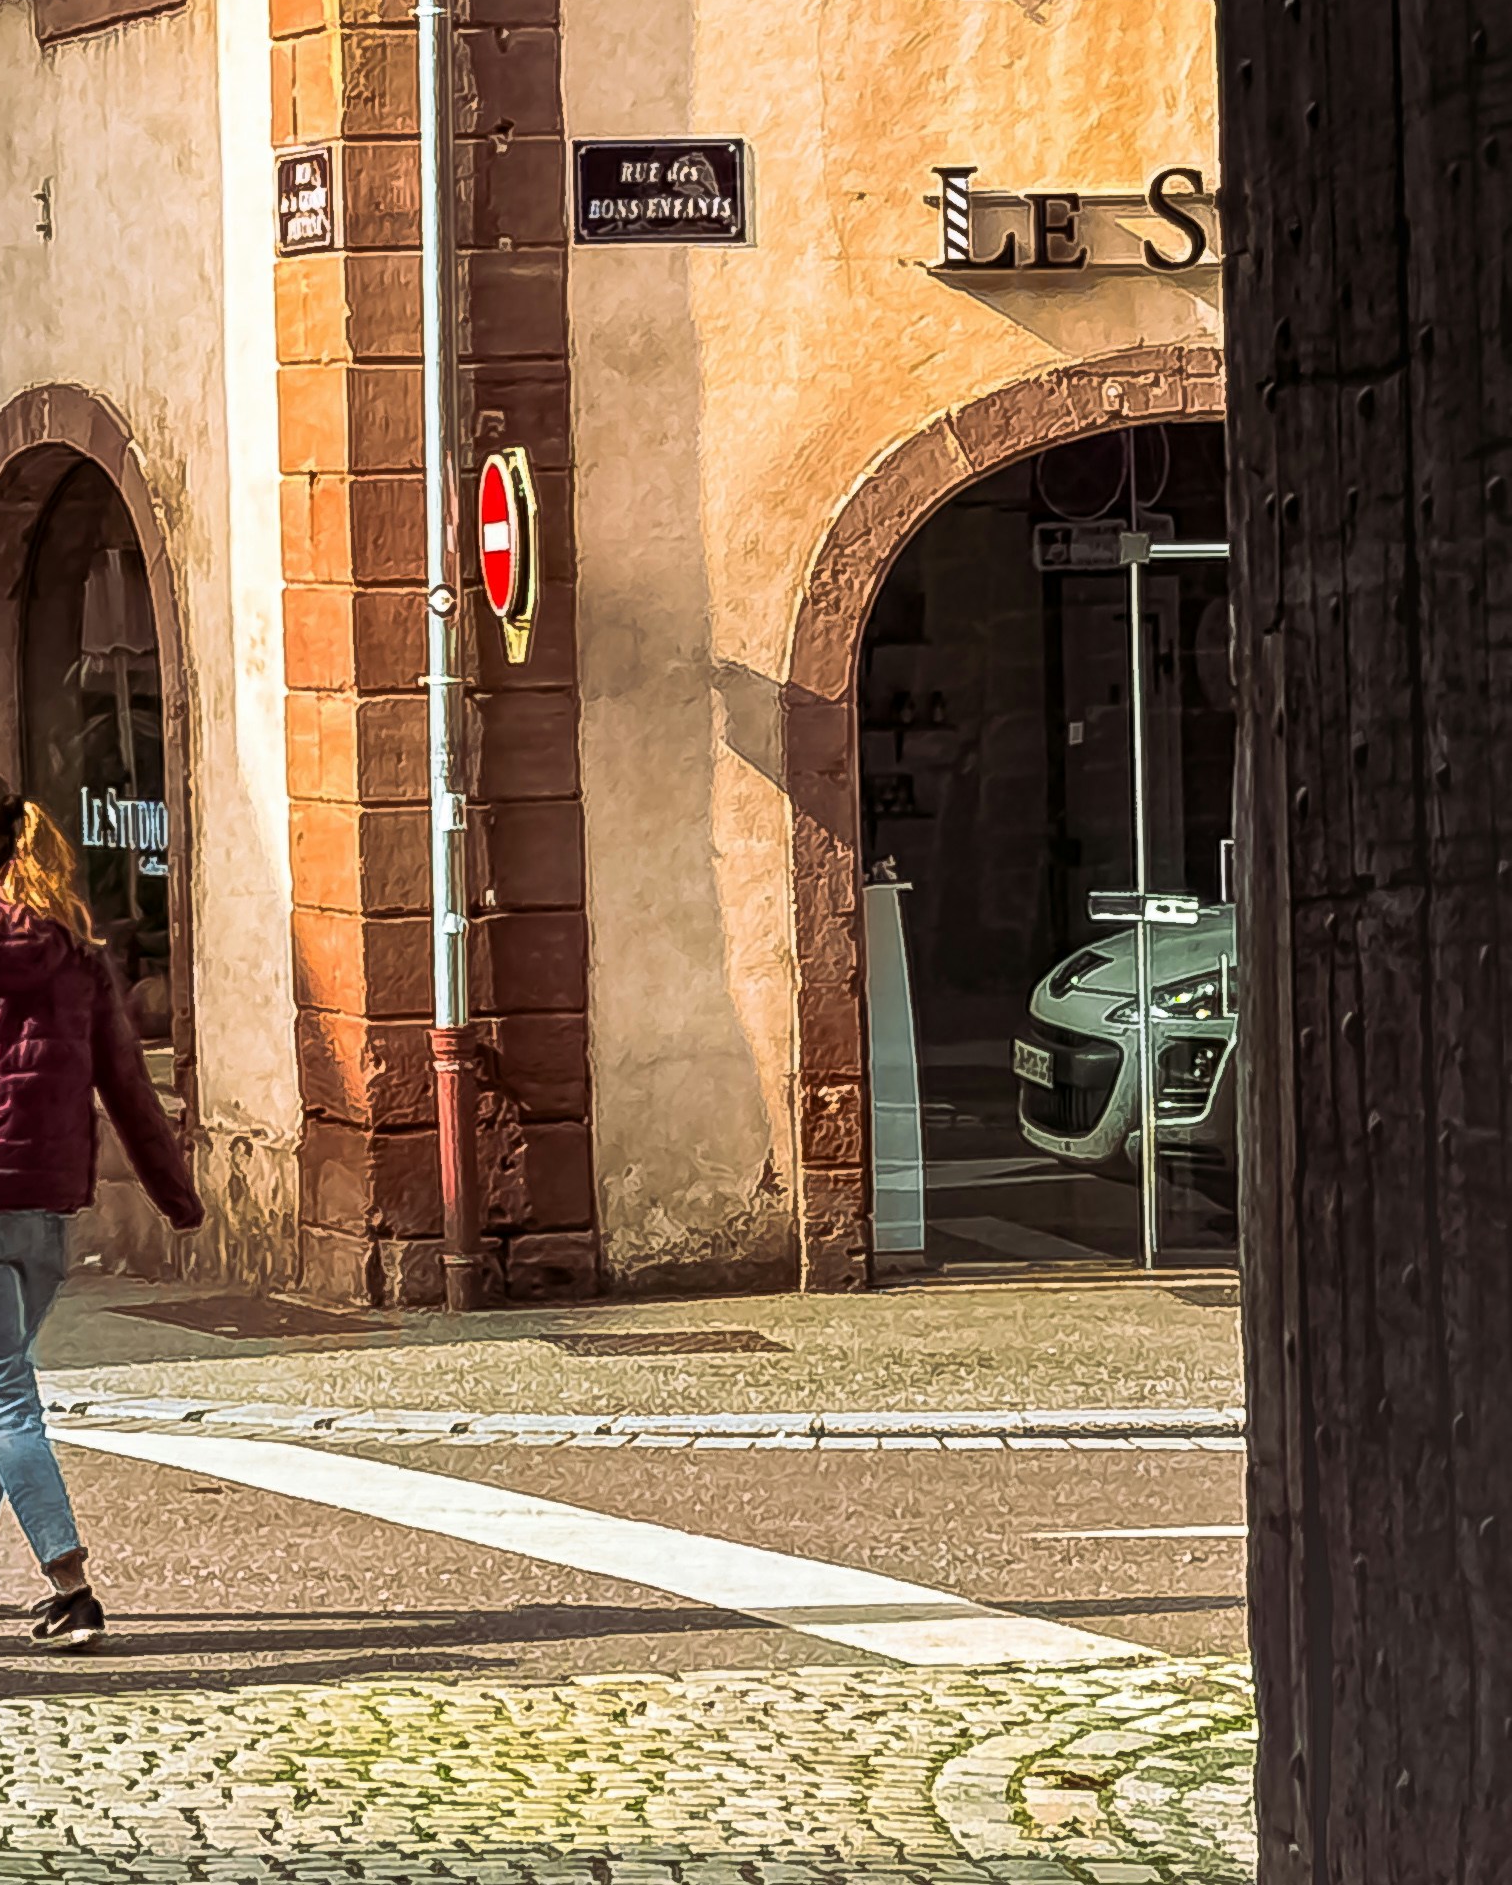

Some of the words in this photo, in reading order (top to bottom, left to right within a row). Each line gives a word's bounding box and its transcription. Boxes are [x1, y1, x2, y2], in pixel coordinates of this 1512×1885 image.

[620, 162, 660, 183] RUE
[588, 198, 640, 219] BONS
[646, 196, 731, 219] ENFANTS
[928, 166, 1088, 271] LE
